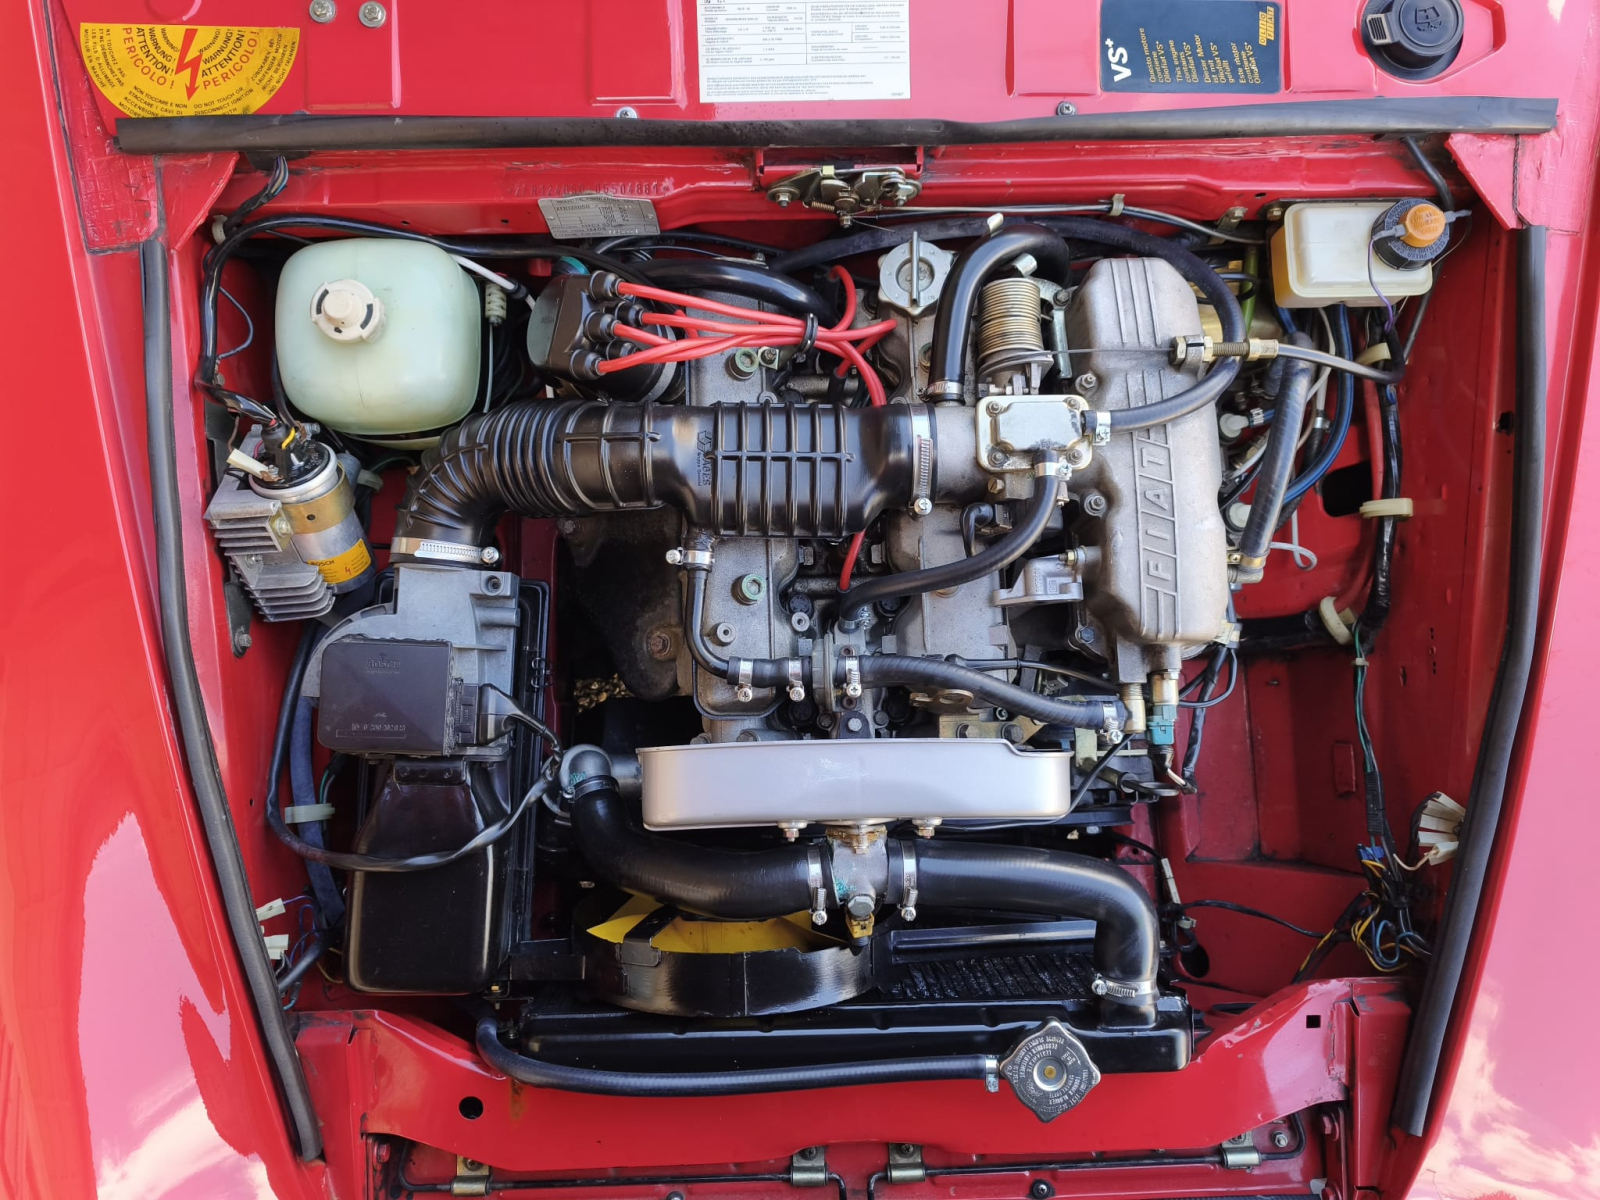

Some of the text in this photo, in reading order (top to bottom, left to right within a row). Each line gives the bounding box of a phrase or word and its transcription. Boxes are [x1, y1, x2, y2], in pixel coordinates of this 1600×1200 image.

[161, 28, 180, 53] WARNING!
[198, 29, 221, 54] WARNING!
[1259, 11, 1267, 46] OLIO
[108, 39, 118, 65] TOUCHEZ
[117, 67, 125, 78] PAS
[136, 27, 174, 76] ATTENTION!
[148, 27, 176, 63] WARNUNG!
[201, 30, 245, 78] ATTENTION!
[202, 29, 234, 65] WARNUNG!
[1139, 28, 1156, 83] Questo motore
[1169, 40, 1179, 64] engine
[1195, 34, 1211, 83] Dieser Motor
[256, 56, 276, 86] LAUFENDEM
[267, 41, 296, 96] UND NICHT TRENNEN
[1152, 51, 1163, 83] contiene
[1161, 57, 1172, 83] Oliofiat
[1179, 52, 1191, 83] contains
[1188, 56, 1198, 83] Oliofiat
[1208, 60, 1216, 73] mit
[1216, 57, 1226, 83] Oliofiat
[1231, 42, 1246, 83] Este motor
[91, 66, 106, 88] MARCHE
[115, 77, 124, 87] PAS
[128, 91, 154, 108] STACCARE
[133, 86, 144, 95] NON
[145, 93, 168, 106] TOCCARE
[194, 103, 230, 115] DISCONNECT
[230, 88, 254, 104] IGNITION
[216, 92, 235, 104] TOUCH
[236, 86, 244, 95] OR
[1141, 447, 1172, 581] FIAT
[310, 559, 335, 568] BOSCH
